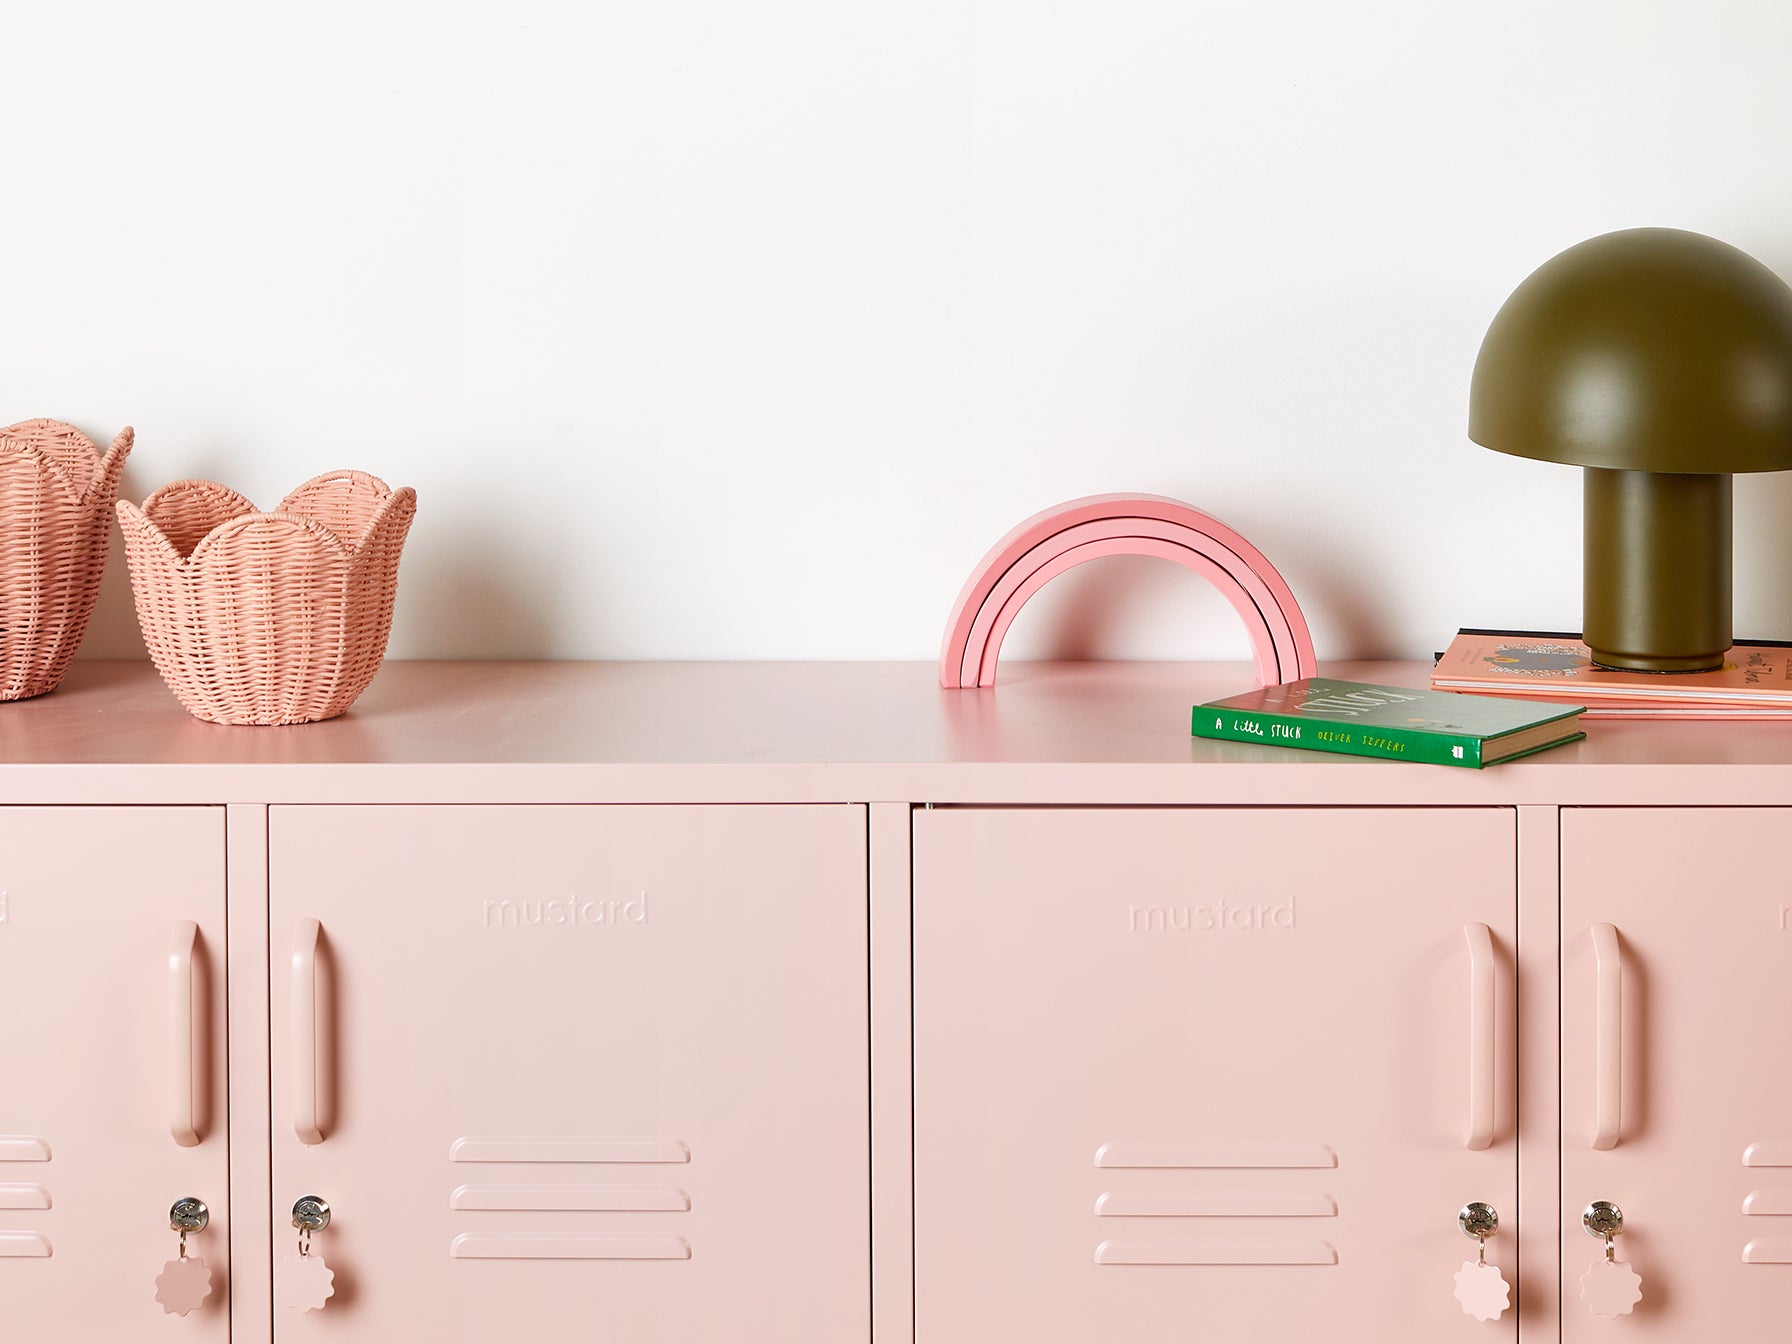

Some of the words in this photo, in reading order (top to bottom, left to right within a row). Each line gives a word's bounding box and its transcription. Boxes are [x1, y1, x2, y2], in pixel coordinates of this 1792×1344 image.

[1215, 717, 1222, 730] A
[1233, 719, 1264, 737] Little
[1271, 723, 1301, 739] STUCK
[1317, 730, 1351, 743] OLIVER
[1362, 735, 1405, 753] JEFFERS
[482, 890, 649, 927] mustard
[1129, 895, 1297, 931] mustard
